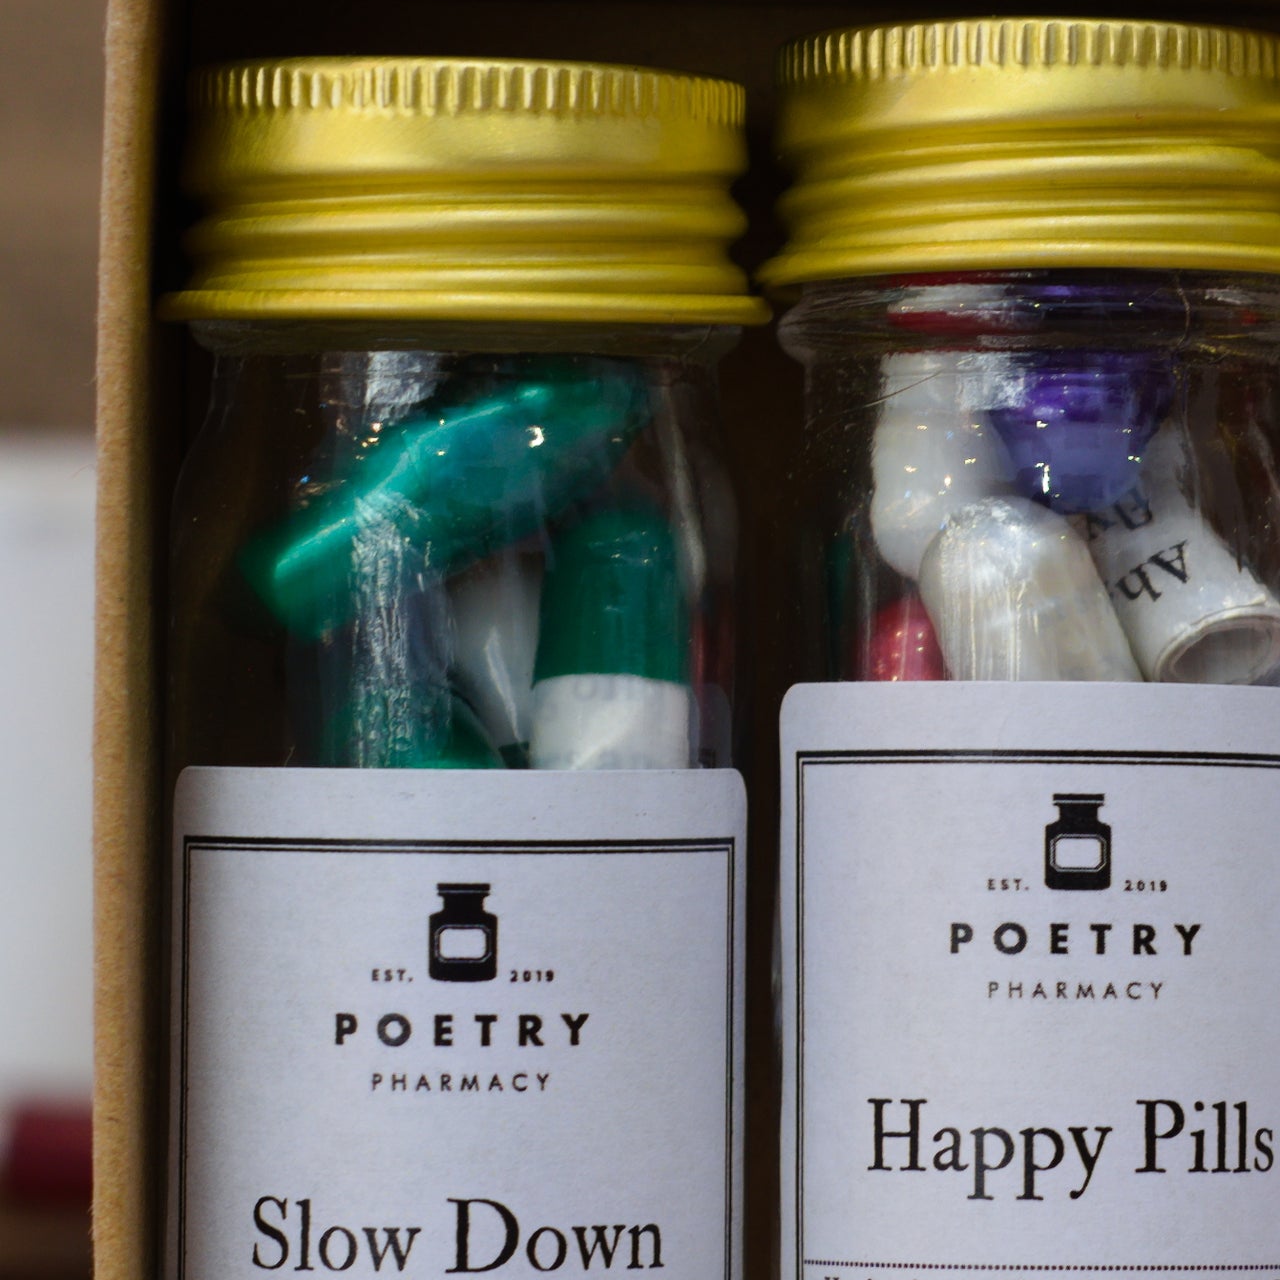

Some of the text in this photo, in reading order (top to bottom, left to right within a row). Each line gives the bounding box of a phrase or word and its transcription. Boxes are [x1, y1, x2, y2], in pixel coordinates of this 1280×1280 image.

[987, 877, 1169, 893] EST. 2019
[949, 921, 1202, 957] POETRY
[371, 968, 556, 984] EST. 2019
[988, 981, 1165, 1001] PHARMACY
[334, 1012, 590, 1048] POETRY
[371, 1072, 551, 1093] PHARMACY
[866, 1097, 1275, 1202] Happy Pills
[251, 1195, 666, 1275] Slow Down
